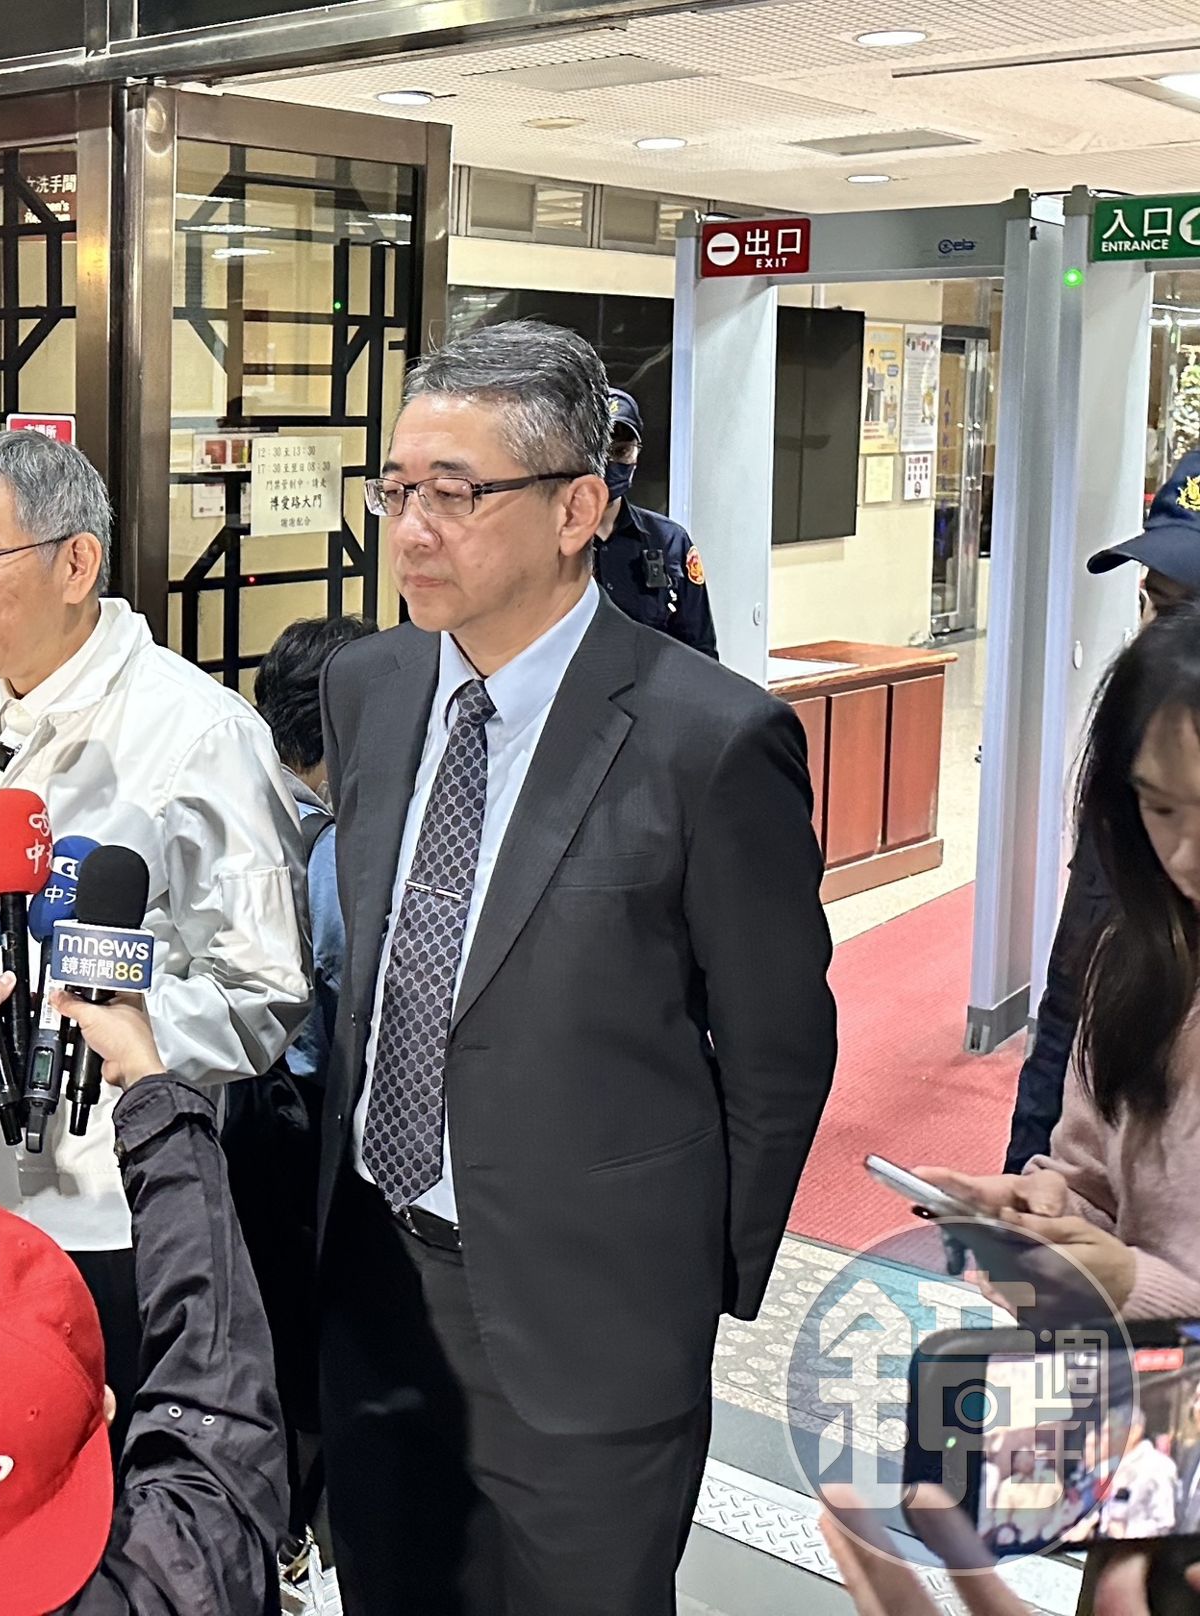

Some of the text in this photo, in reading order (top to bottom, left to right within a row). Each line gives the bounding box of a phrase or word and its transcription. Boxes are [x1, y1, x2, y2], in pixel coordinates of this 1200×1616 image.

[1102, 207, 1173, 239] 入口
[744, 229, 802, 256] 出口
[1101, 239, 1169, 252] ENTRANCE
[756, 257, 788, 269] EXIT
[270, 493, 322, 511] 博愛路大門
[58, 933, 150, 961] mnews
